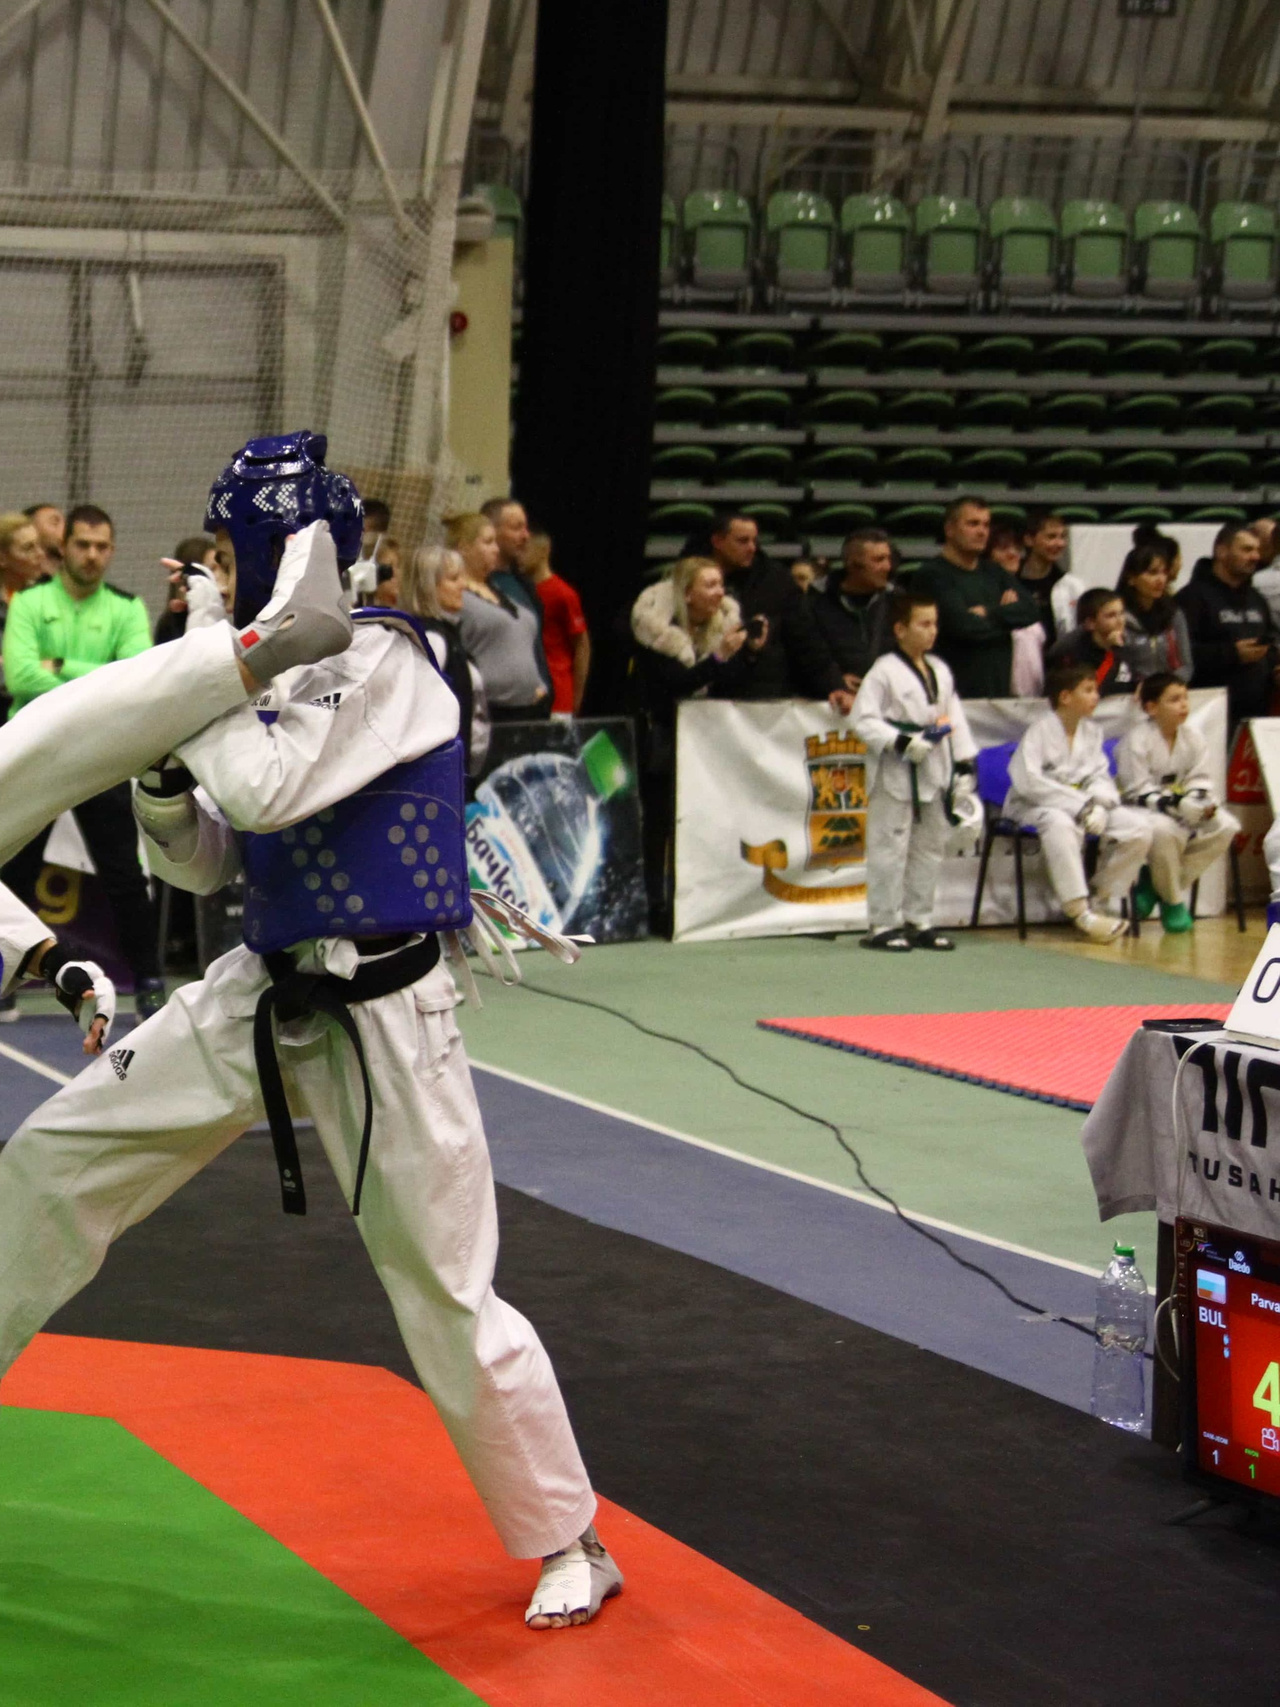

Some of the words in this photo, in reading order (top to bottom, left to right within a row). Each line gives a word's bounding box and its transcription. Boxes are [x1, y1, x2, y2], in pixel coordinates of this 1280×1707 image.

[1228, 1257, 1251, 1275] Daedo
[1199, 1305, 1227, 1329] BUL
[1252, 1361, 1280, 1428] 4
[1212, 1449, 1219, 1465] 1
[1248, 1463, 1255, 1479] 1
